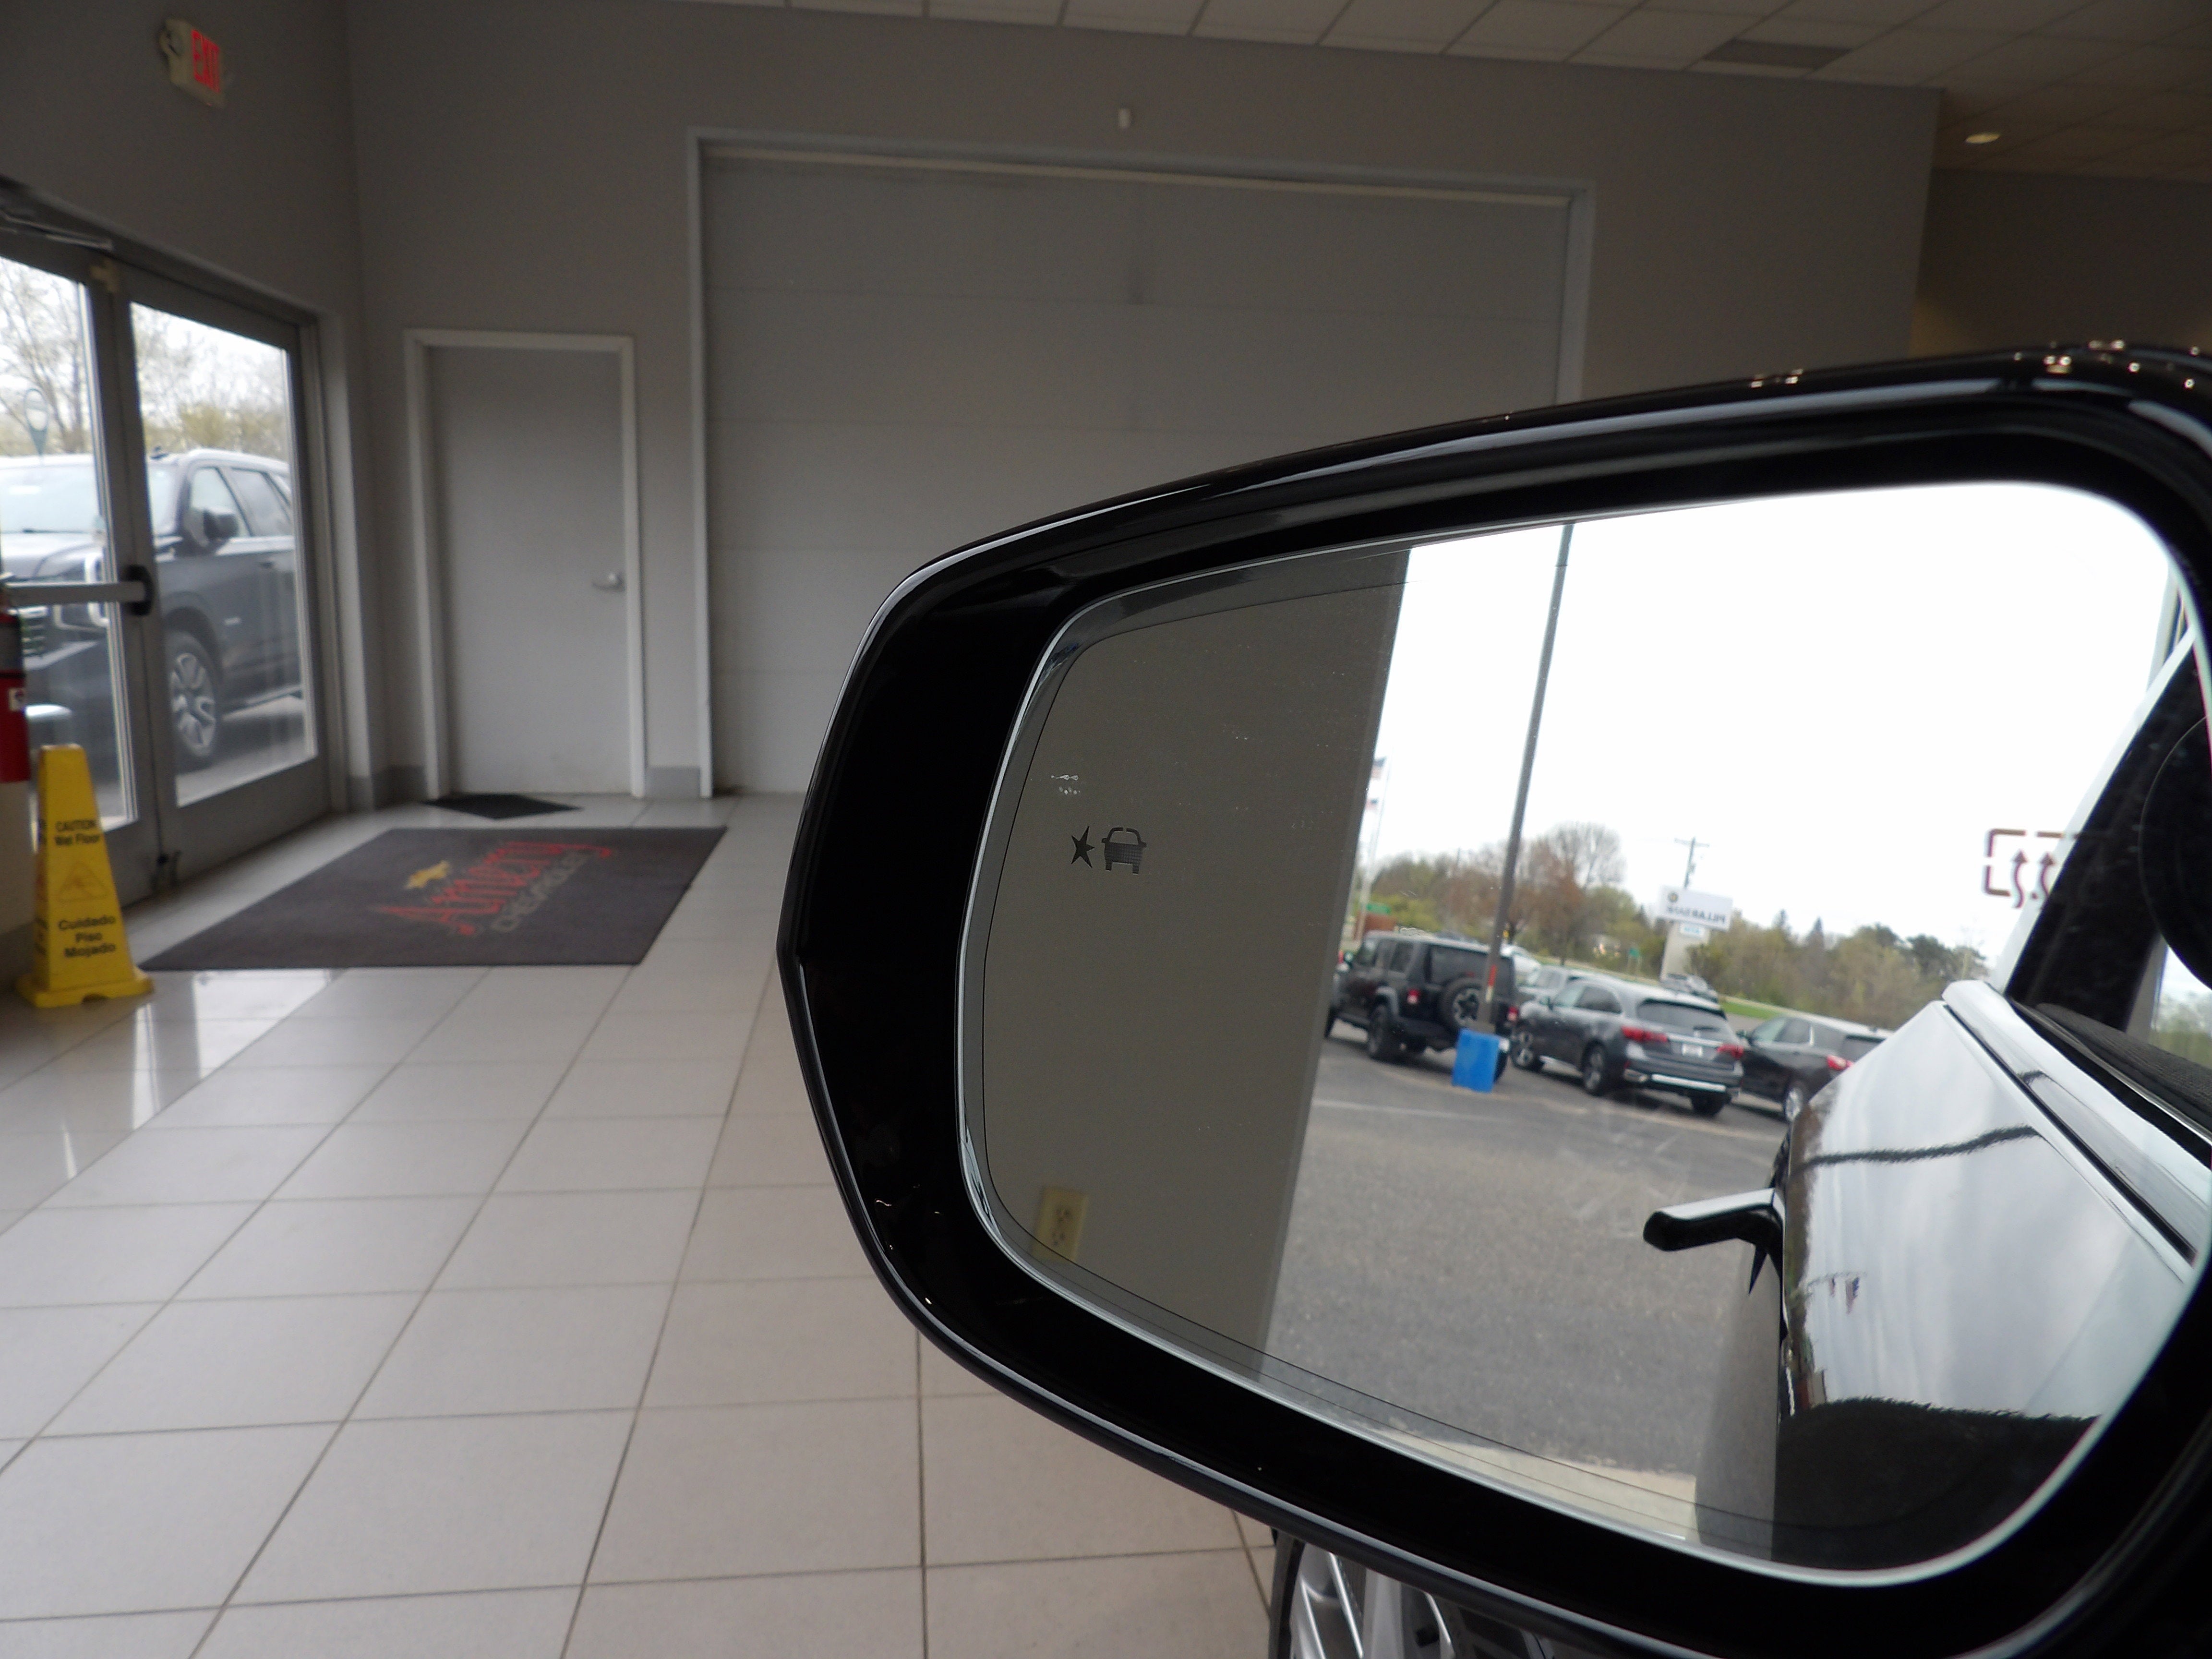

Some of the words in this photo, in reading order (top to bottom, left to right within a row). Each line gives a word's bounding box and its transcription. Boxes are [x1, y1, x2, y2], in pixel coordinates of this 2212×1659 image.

[191, 28, 220, 93] EXIT
[55, 819, 96, 832] CAUTION
[54, 835, 72, 846] Wet
[76, 832, 100, 844] Floor
[58, 914, 116, 930] Cuidado
[75, 932, 102, 943] Piso
[64, 943, 116, 957] Mojado
